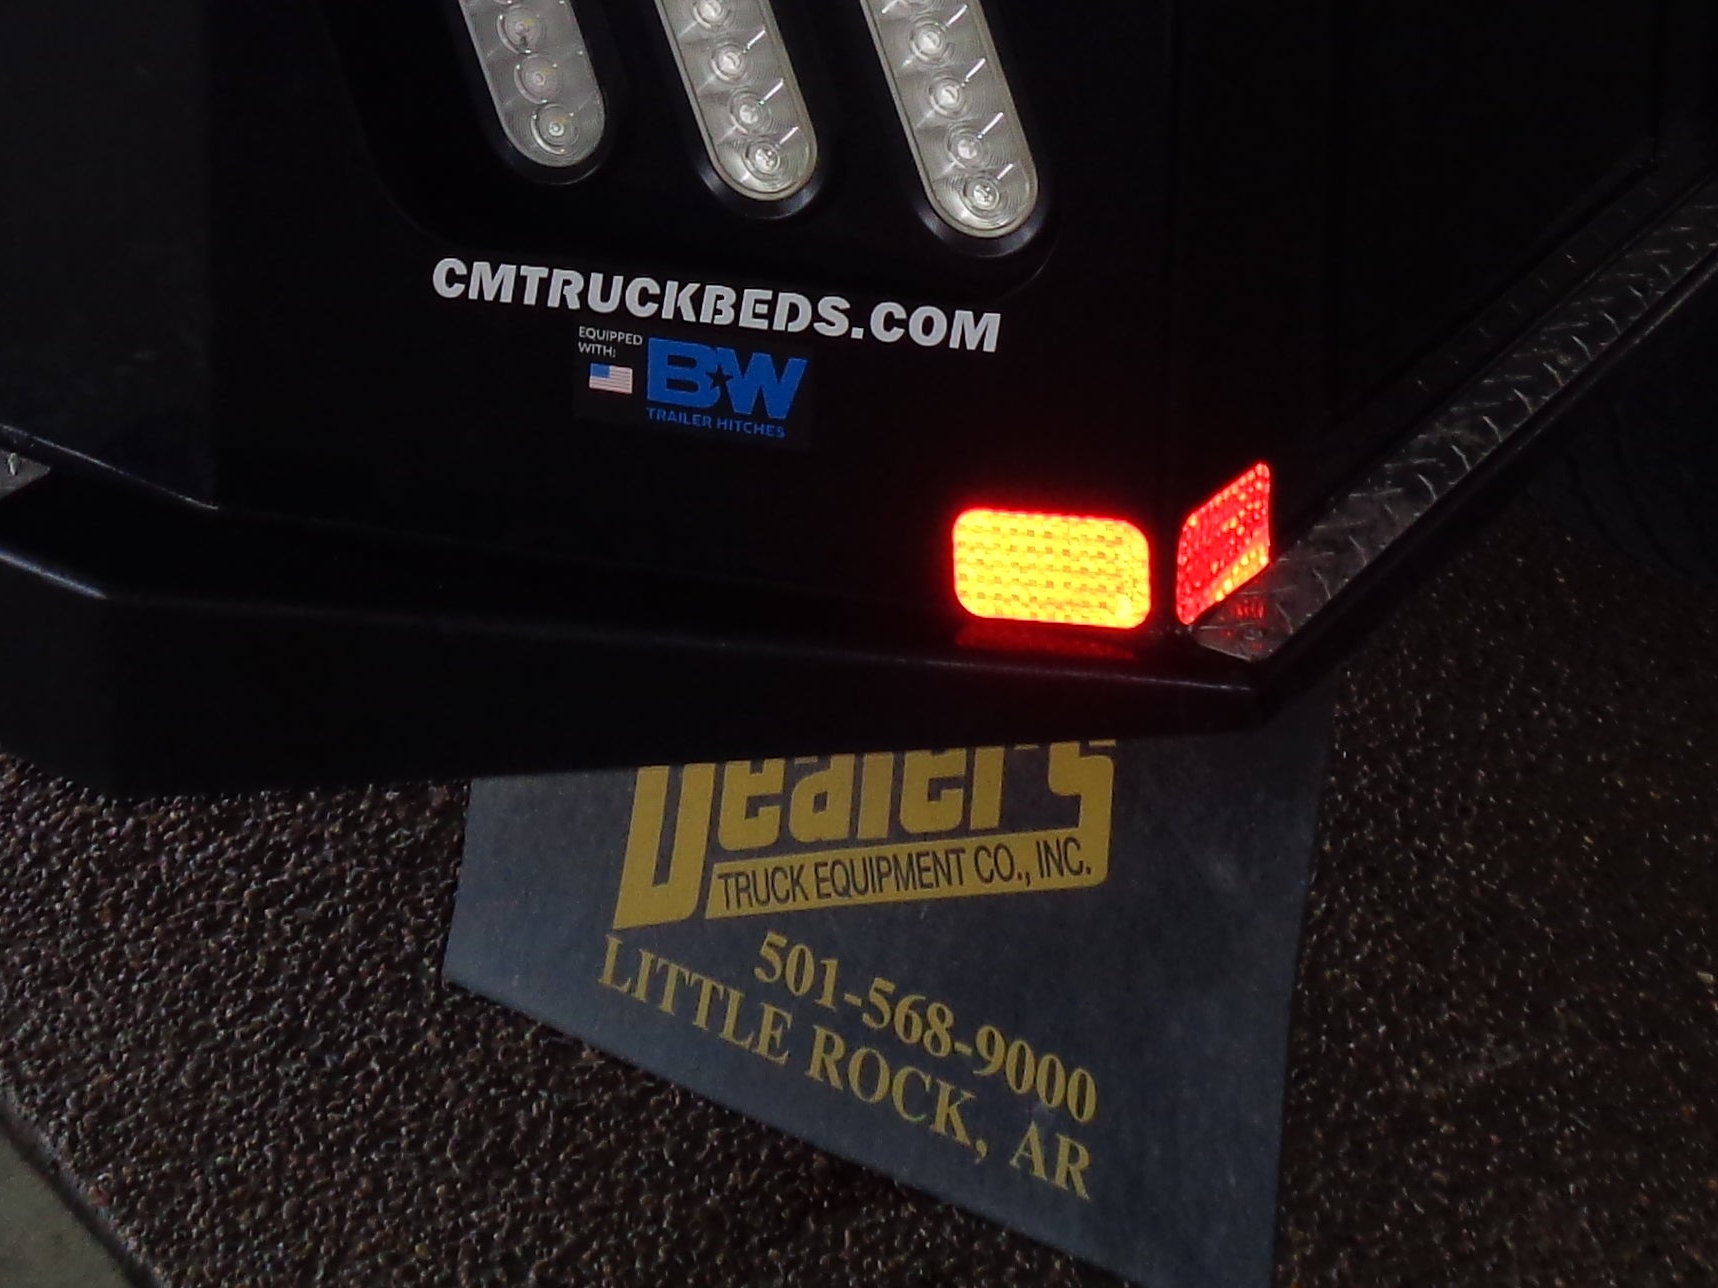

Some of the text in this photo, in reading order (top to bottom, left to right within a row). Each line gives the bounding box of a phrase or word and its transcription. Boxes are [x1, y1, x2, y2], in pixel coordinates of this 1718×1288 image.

[432, 256, 1002, 354] CMTRUCKBEDS.COM
[577, 325, 643, 347] EQUIPPED
[577, 340, 617, 359] WITH:
[646, 406, 786, 439] TRAILER HITCHES
[717, 836, 1093, 912] TRUCK EQUIPMENT CO., INC.
[752, 931, 1098, 1126] 501-568-9000
[595, 935, 1093, 1203] LITTLE ROCK, AR
